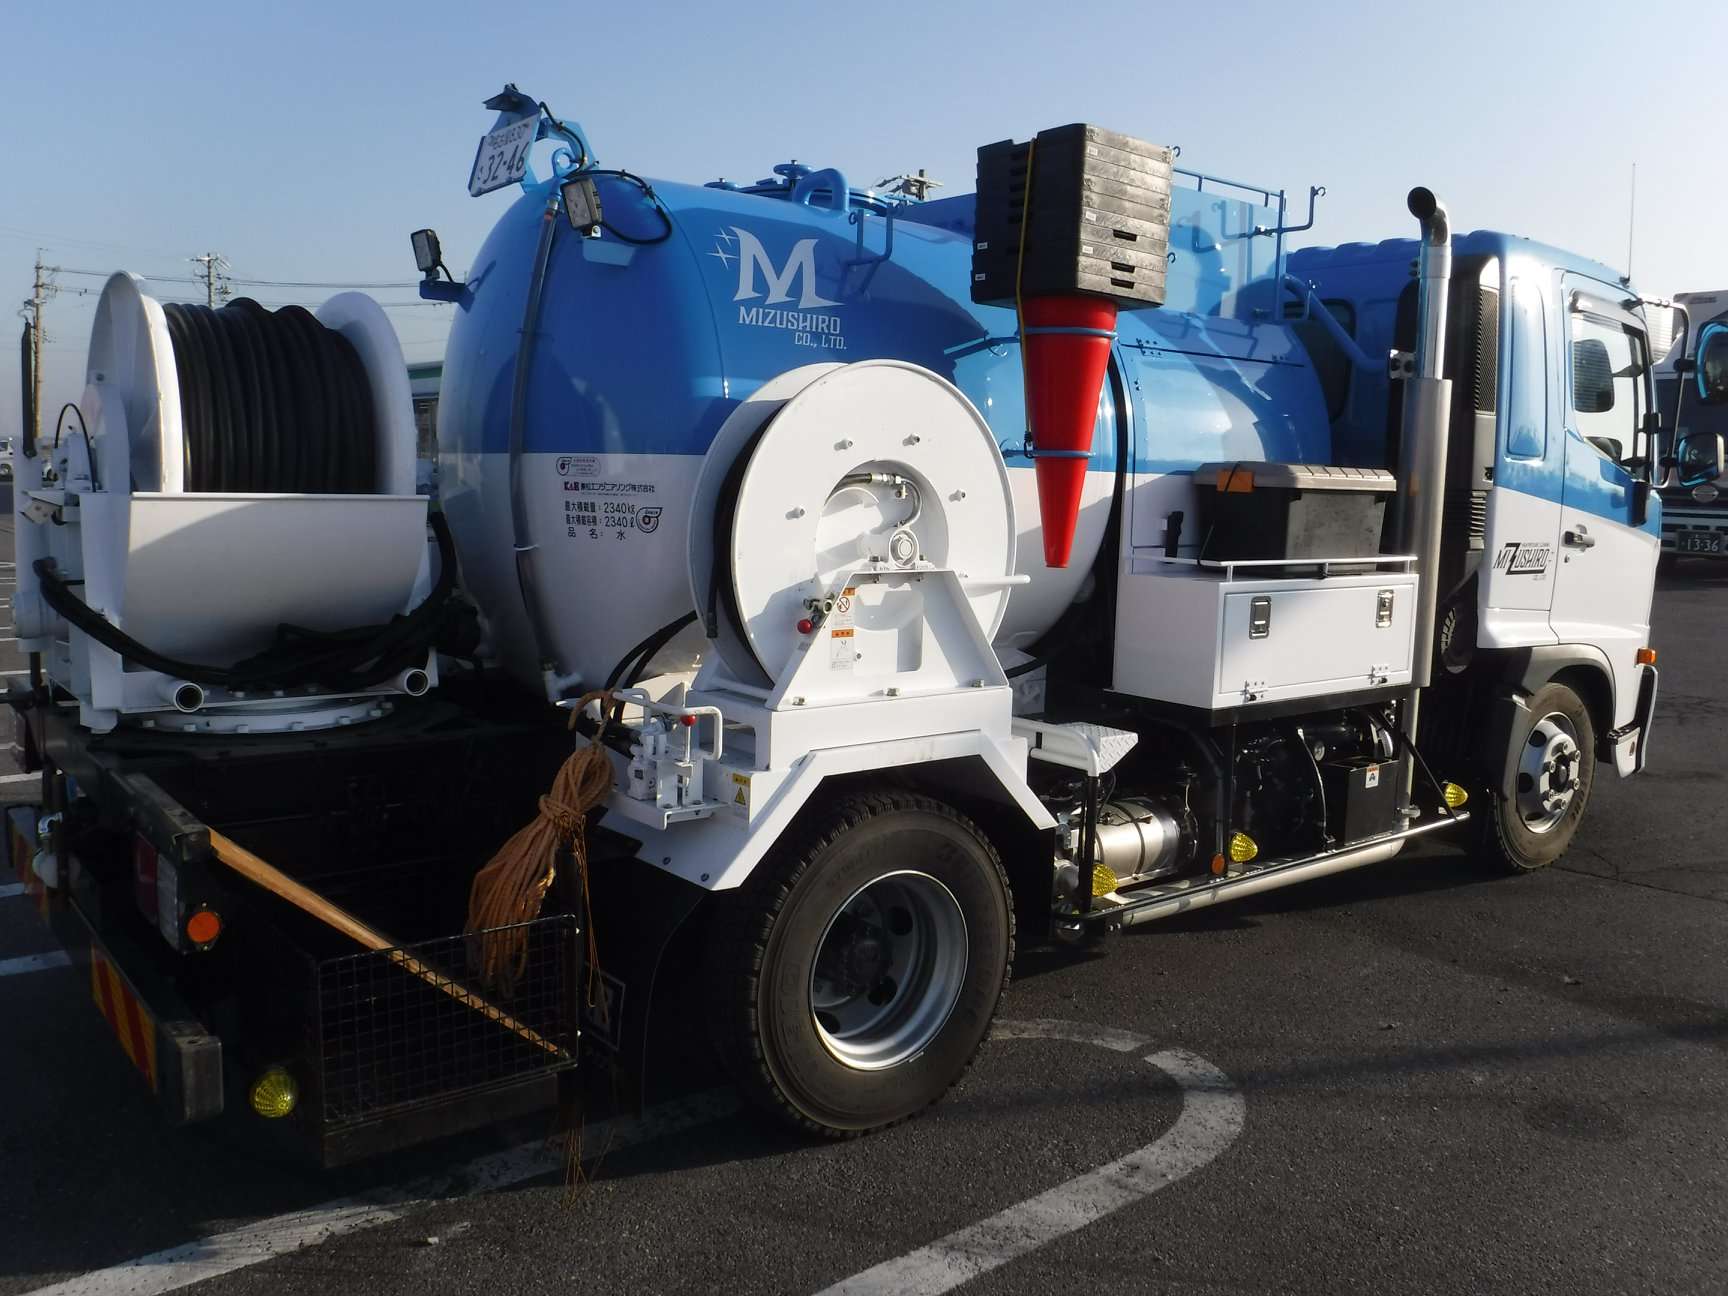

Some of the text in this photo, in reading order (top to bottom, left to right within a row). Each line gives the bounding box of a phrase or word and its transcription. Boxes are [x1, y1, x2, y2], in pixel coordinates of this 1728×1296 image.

[729, 226, 846, 309] M
[738, 305, 841, 334] MIZUSHIRO
[795, 332, 847, 350] CO., LTD.
[1493, 542, 1550, 575] MIZUSHIRO
